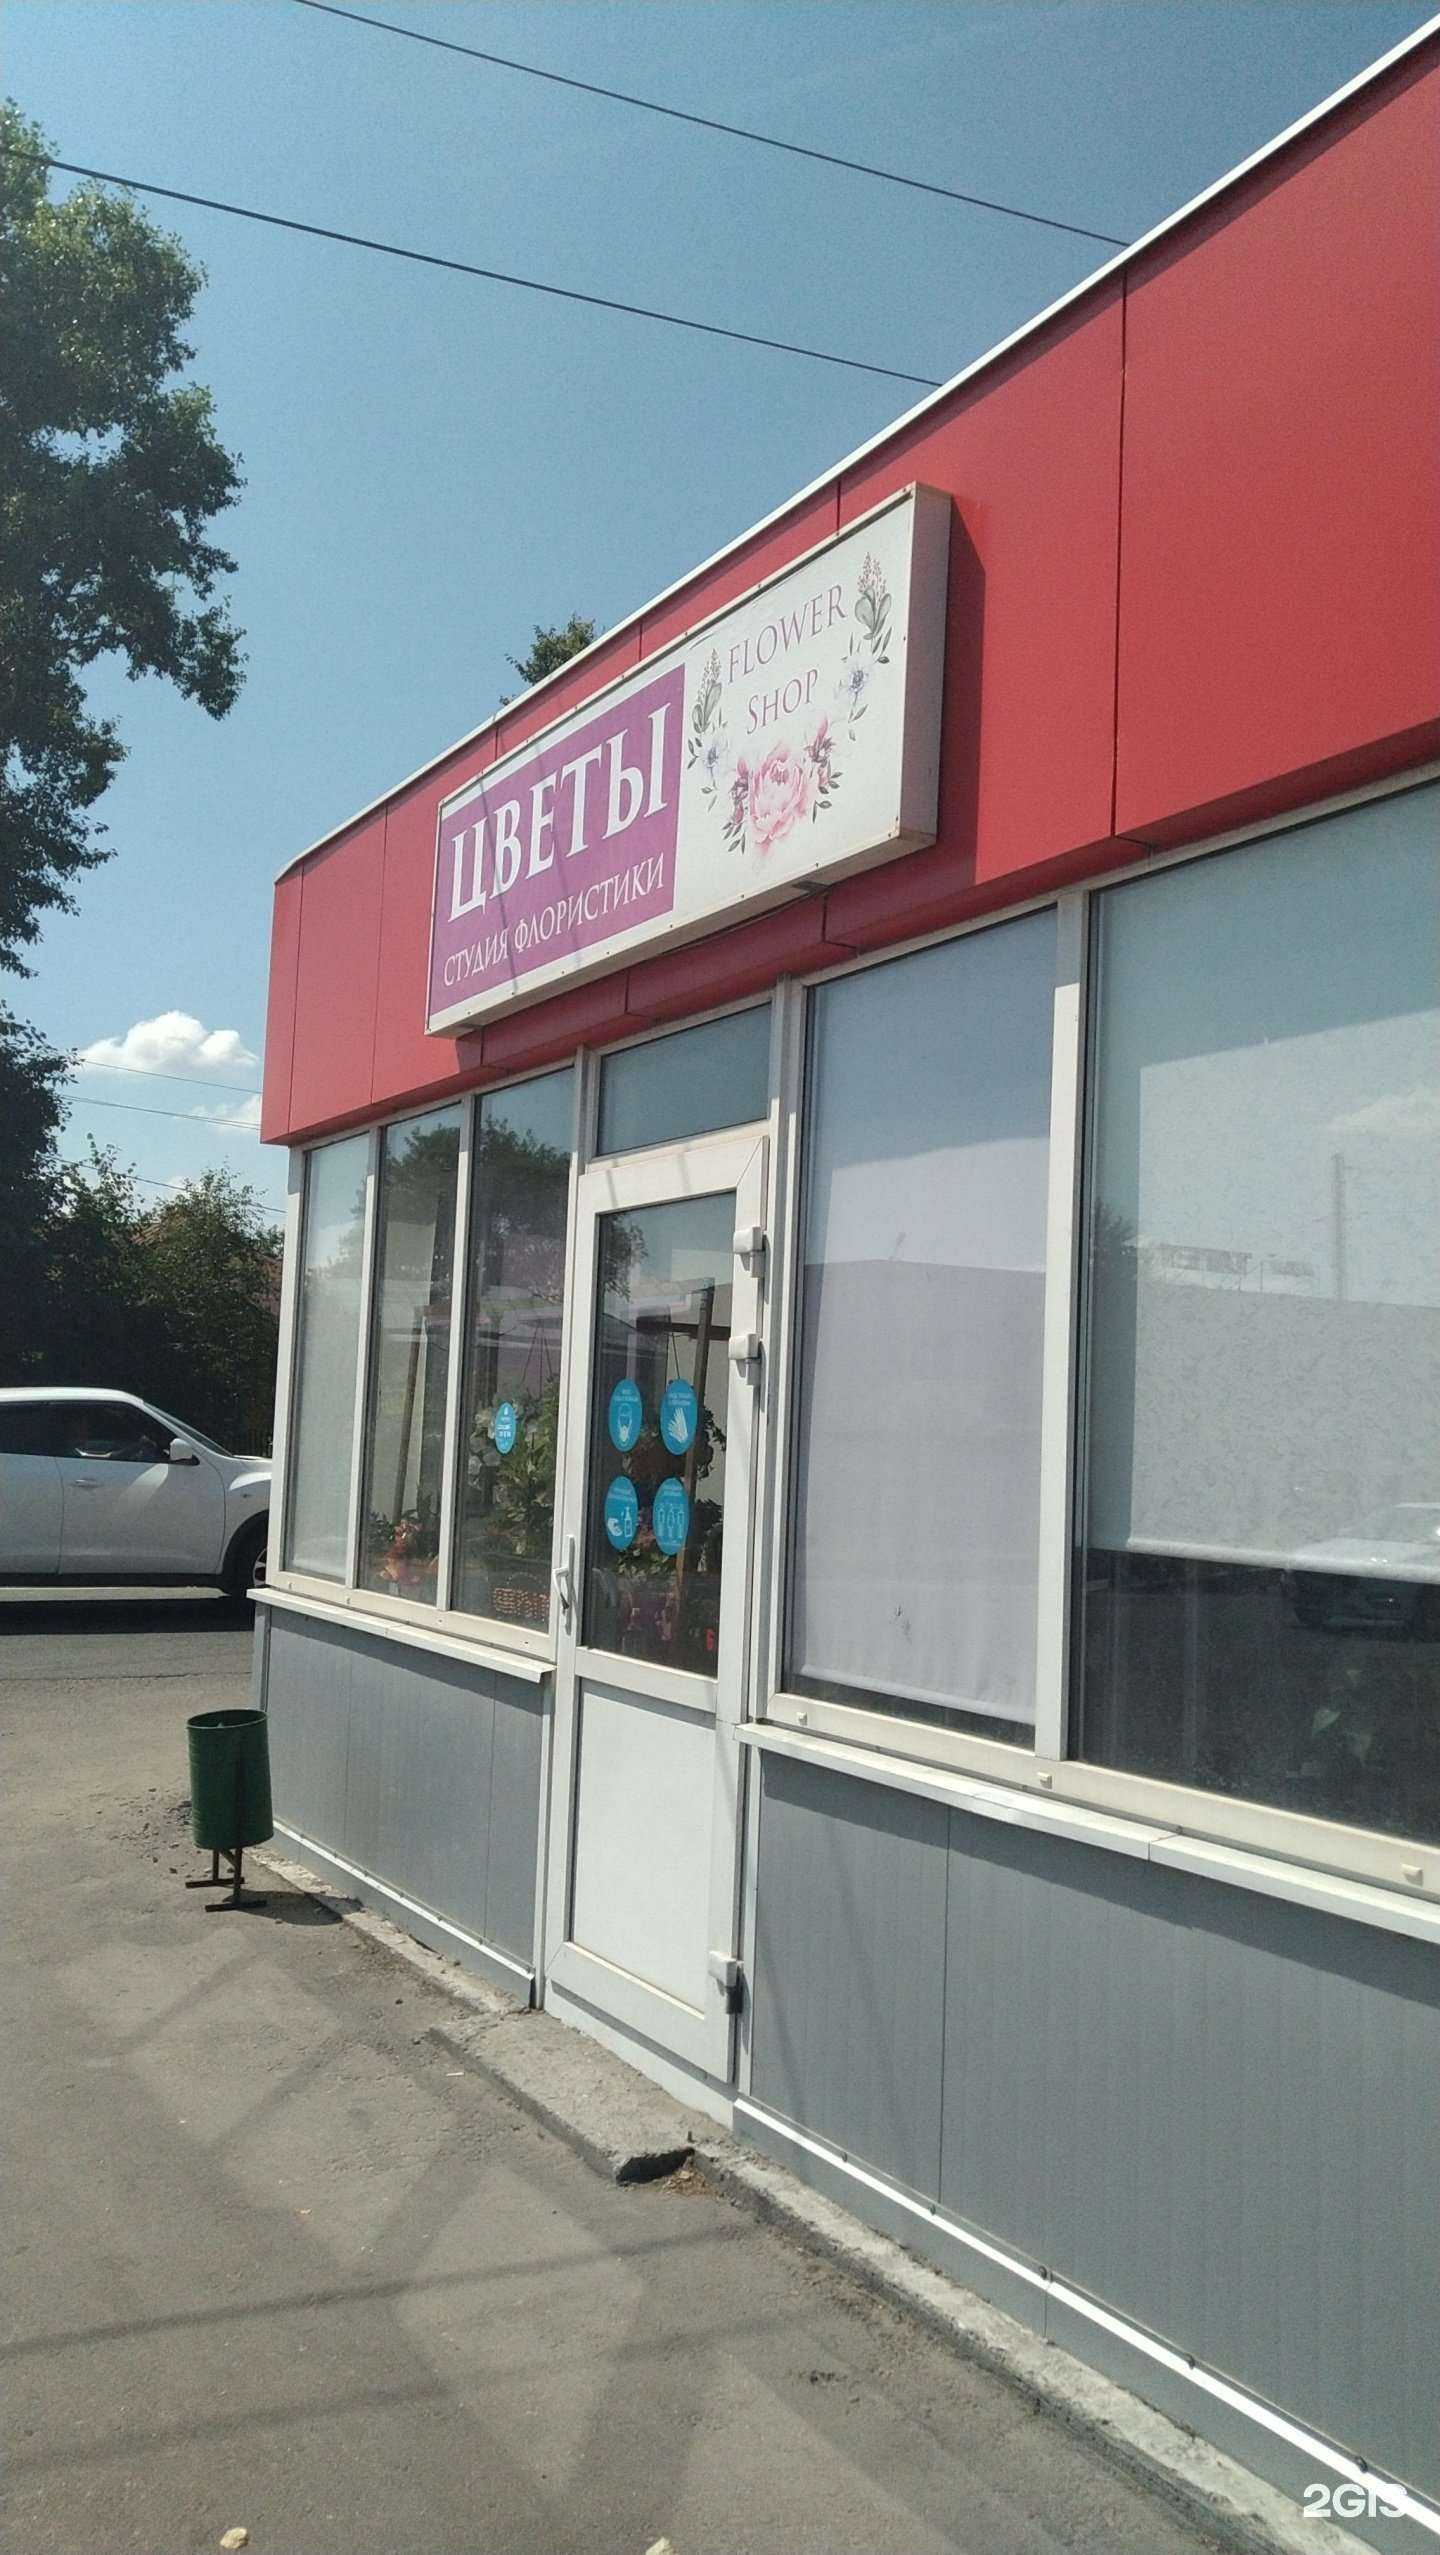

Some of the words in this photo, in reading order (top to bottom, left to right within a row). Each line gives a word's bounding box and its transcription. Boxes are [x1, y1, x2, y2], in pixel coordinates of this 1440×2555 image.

[728, 585, 846, 684] FLOWER
[747, 669, 818, 735] SHOP
[449, 703, 671, 922] ЦВЕТЫ
[444, 932, 509, 987] СТУДИЯ
[515, 853, 665, 952] ФЛОРИСТИКИ
